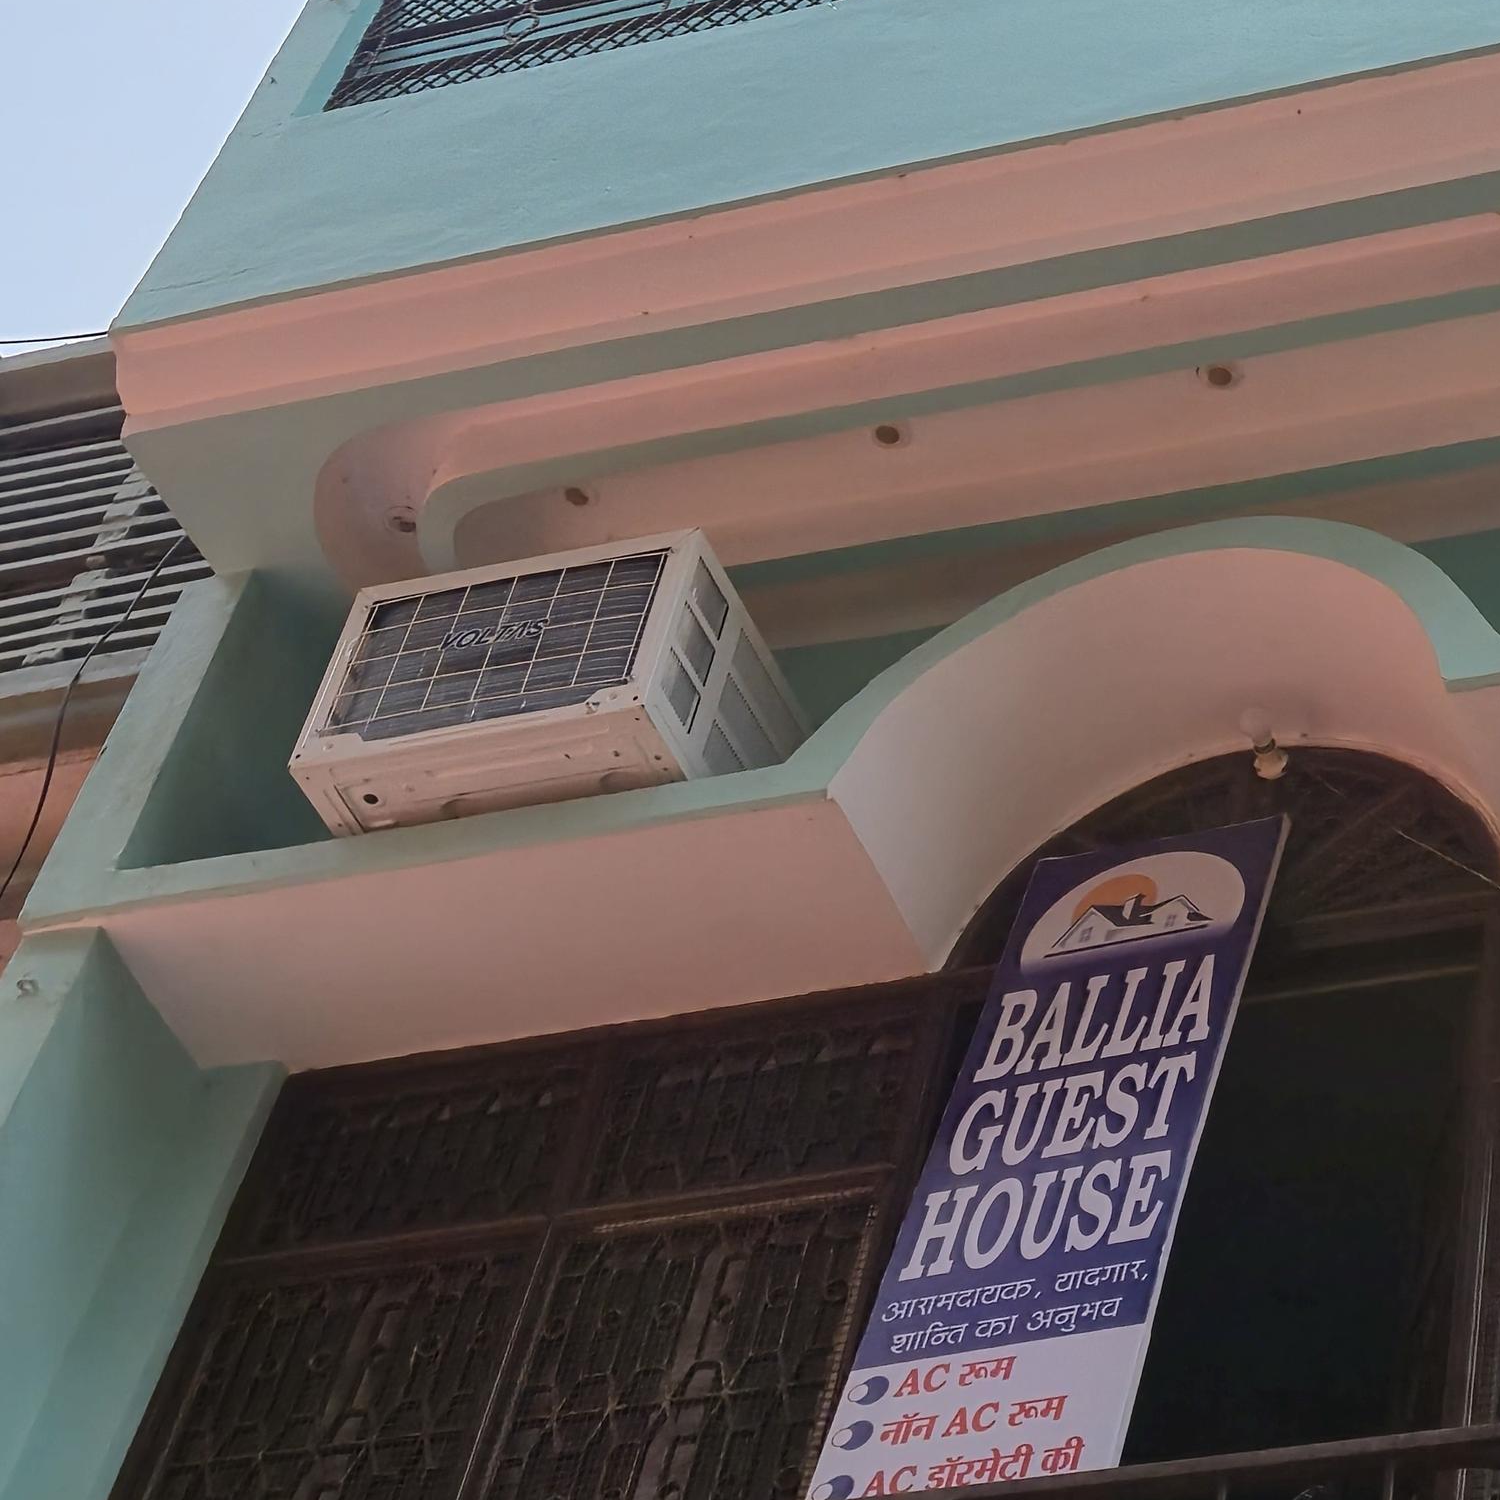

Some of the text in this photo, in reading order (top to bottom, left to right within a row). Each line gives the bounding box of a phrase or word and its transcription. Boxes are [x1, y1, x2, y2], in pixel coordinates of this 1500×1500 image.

[440, 617, 550, 651] VOLTAS
[973, 953, 1217, 1084] BALLIA
[948, 1052, 1197, 1176] GUEST
[898, 1149, 1172, 1283] HOUSE
[974, 1313, 1019, 1340] का
[1026, 1296, 1123, 1333] अनुभव
[893, 1355, 1017, 1399] AC रूम
[879, 1394, 1068, 1446] नॉन AC रूम
[861, 1465, 918, 1499] AC
[1040, 1435, 1086, 1474] की
